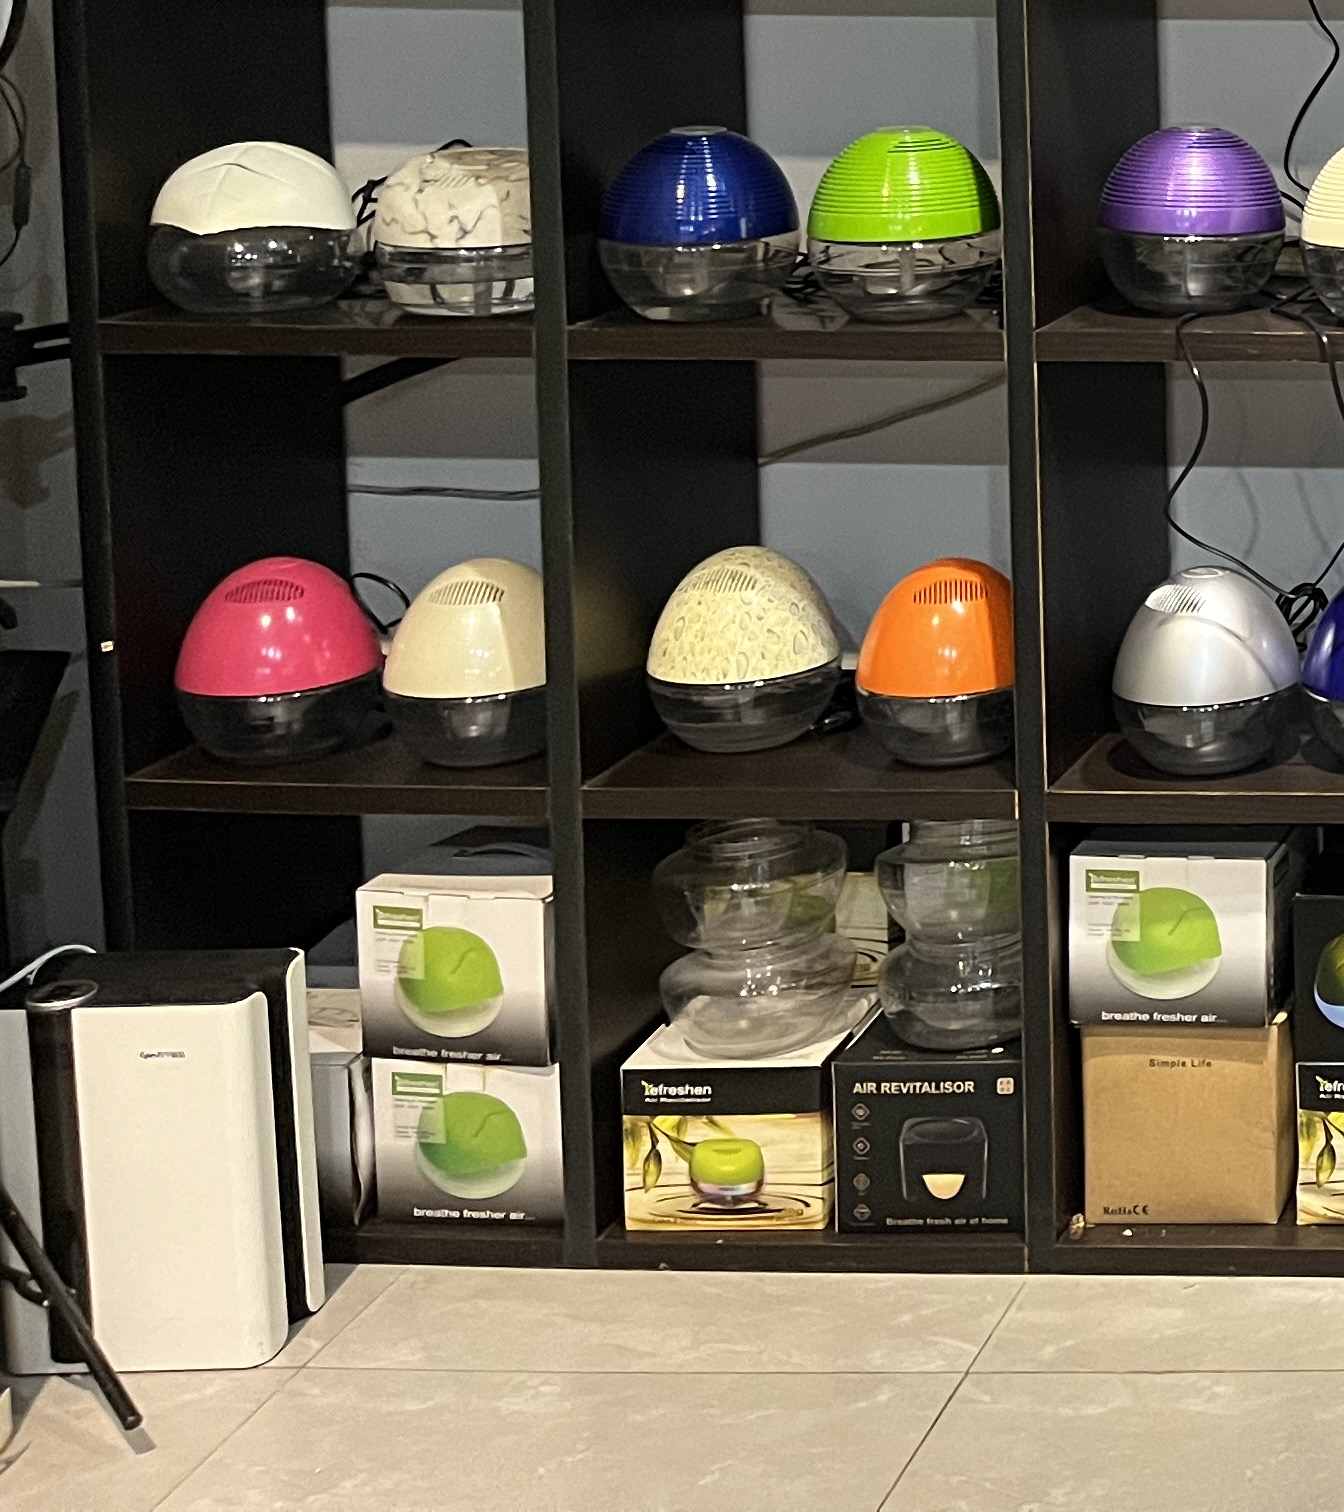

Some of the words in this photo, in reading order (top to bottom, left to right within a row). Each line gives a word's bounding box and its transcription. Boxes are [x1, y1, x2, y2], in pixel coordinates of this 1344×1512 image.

[1101, 1010, 1150, 1021] breathe
[1153, 1011, 1198, 1022] fresher
[1148, 1058, 1187, 1069] Simple
[1191, 1058, 1212, 1068] Life
[852, 1082, 878, 1094] AIR
[880, 1081, 975, 1094] REVITALISOR
[413, 1206, 461, 1218] breathe
[463, 1209, 507, 1220] fresher
